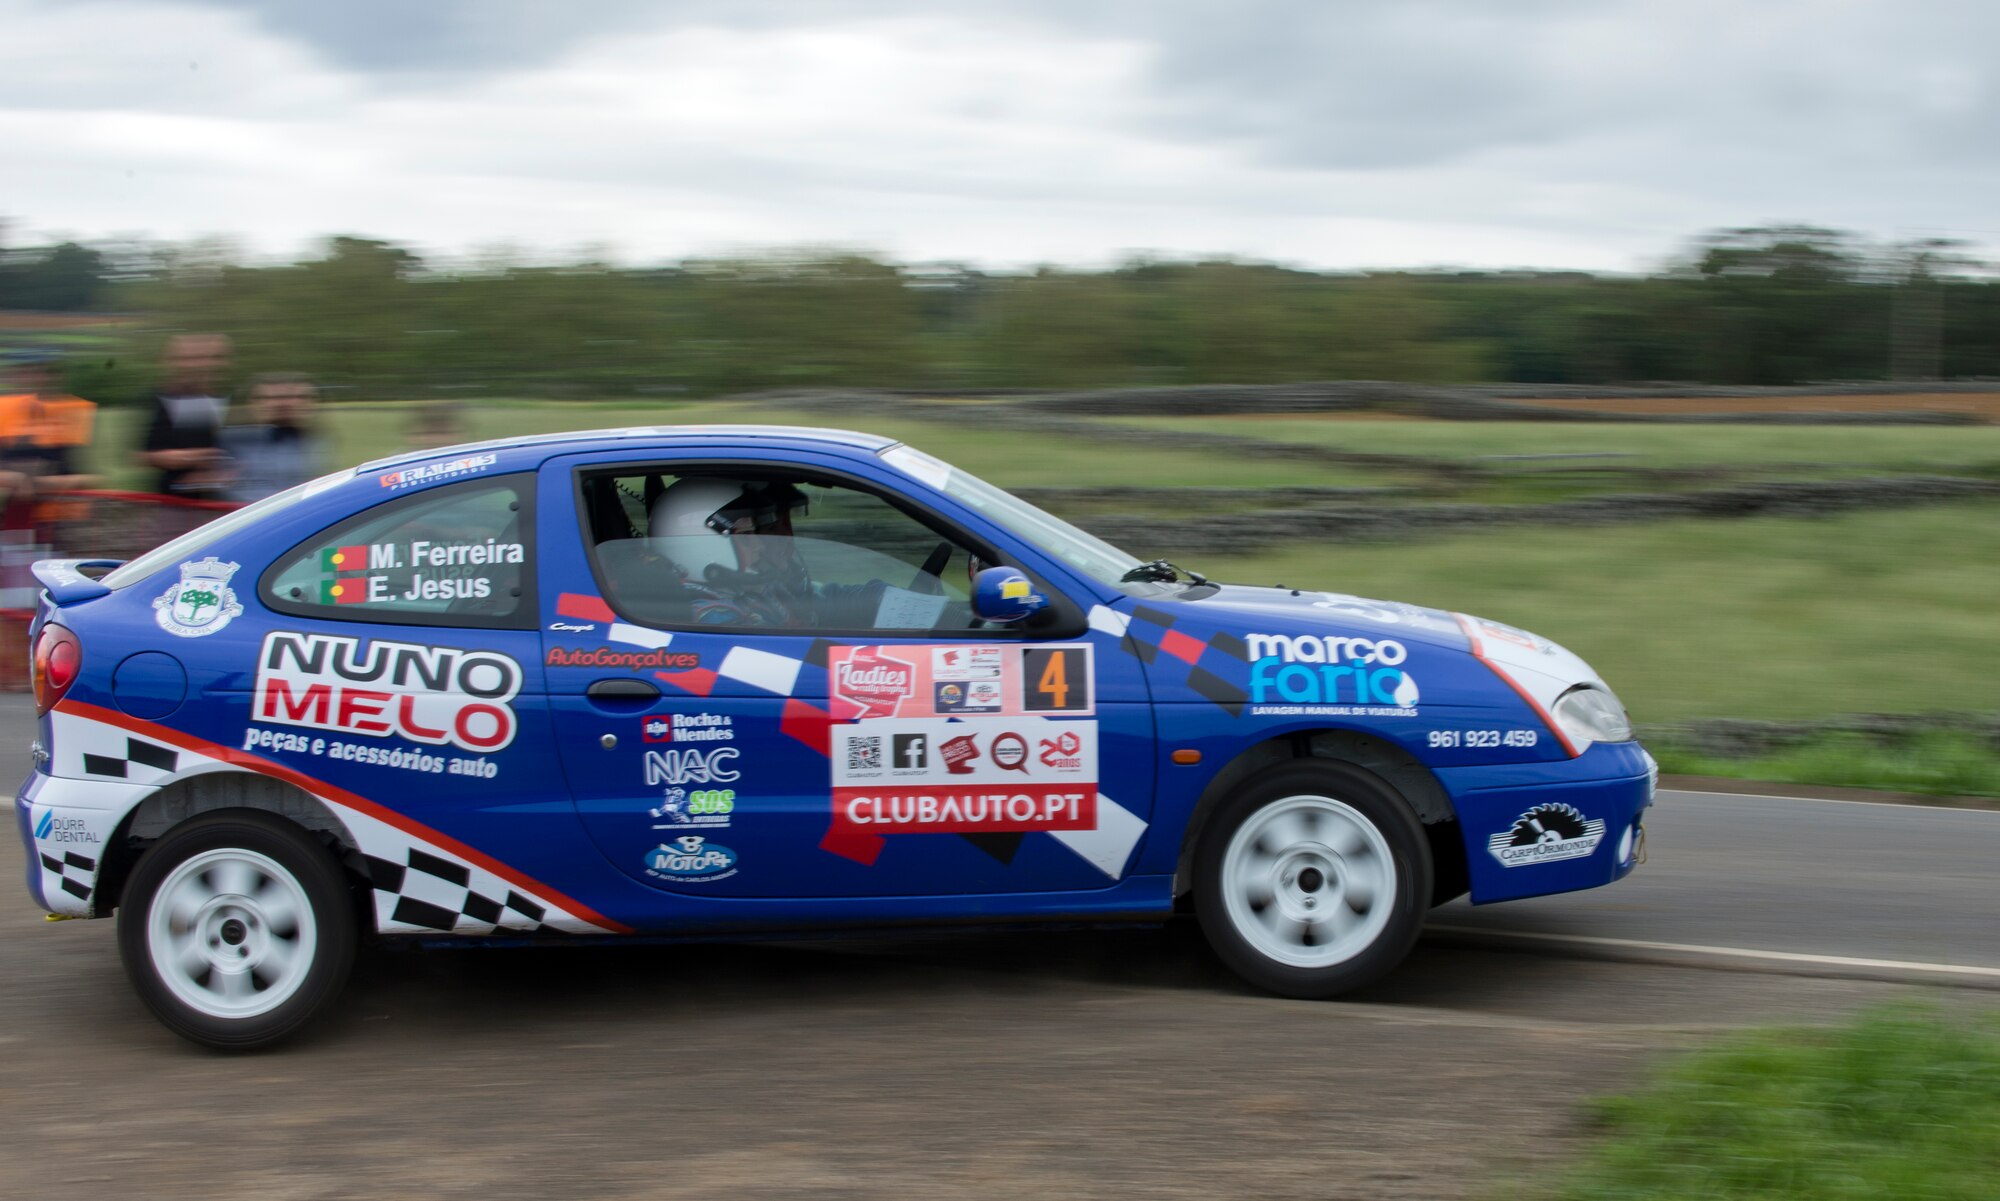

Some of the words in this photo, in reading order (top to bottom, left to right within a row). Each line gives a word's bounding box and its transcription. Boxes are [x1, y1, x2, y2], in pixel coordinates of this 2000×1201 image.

[390, 465, 487, 490] PUBLICIDADE
[370, 543, 403, 569] M.
[411, 538, 524, 567] Ferreira
[368, 576, 396, 602] E.
[405, 574, 491, 601] Jesus
[546, 648, 699, 671] AutoGonçalves
[1245, 633, 1408, 666] marco
[266, 636, 514, 699] NUNO
[839, 664, 907, 691] Ladies
[1038, 650, 1070, 708] 4
[262, 677, 510, 748] MELO
[672, 712, 722, 728] Rocha
[723, 715, 733, 726] &
[1252, 706, 1304, 716] LAVAGEM
[1305, 706, 1351, 716] MANUAL
[1352, 707, 1367, 716] DE
[1367, 708, 1419, 717] VIATURAS
[672, 727, 735, 742] Mendes
[1428, 730, 1461, 748] 961
[1464, 730, 1501, 748] 923
[1502, 730, 1538, 747] 459
[243, 727, 310, 753] peças
[311, 738, 325, 756] e
[328, 743, 445, 773] acessórios
[448, 757, 499, 778] auto
[643, 747, 741, 785] NAC
[688, 788, 735, 814] SOS
[846, 793, 1085, 824] CLUBAUTO.PT
[53, 816, 86, 831] DÜRR
[54, 831, 101, 843] DENTAL
